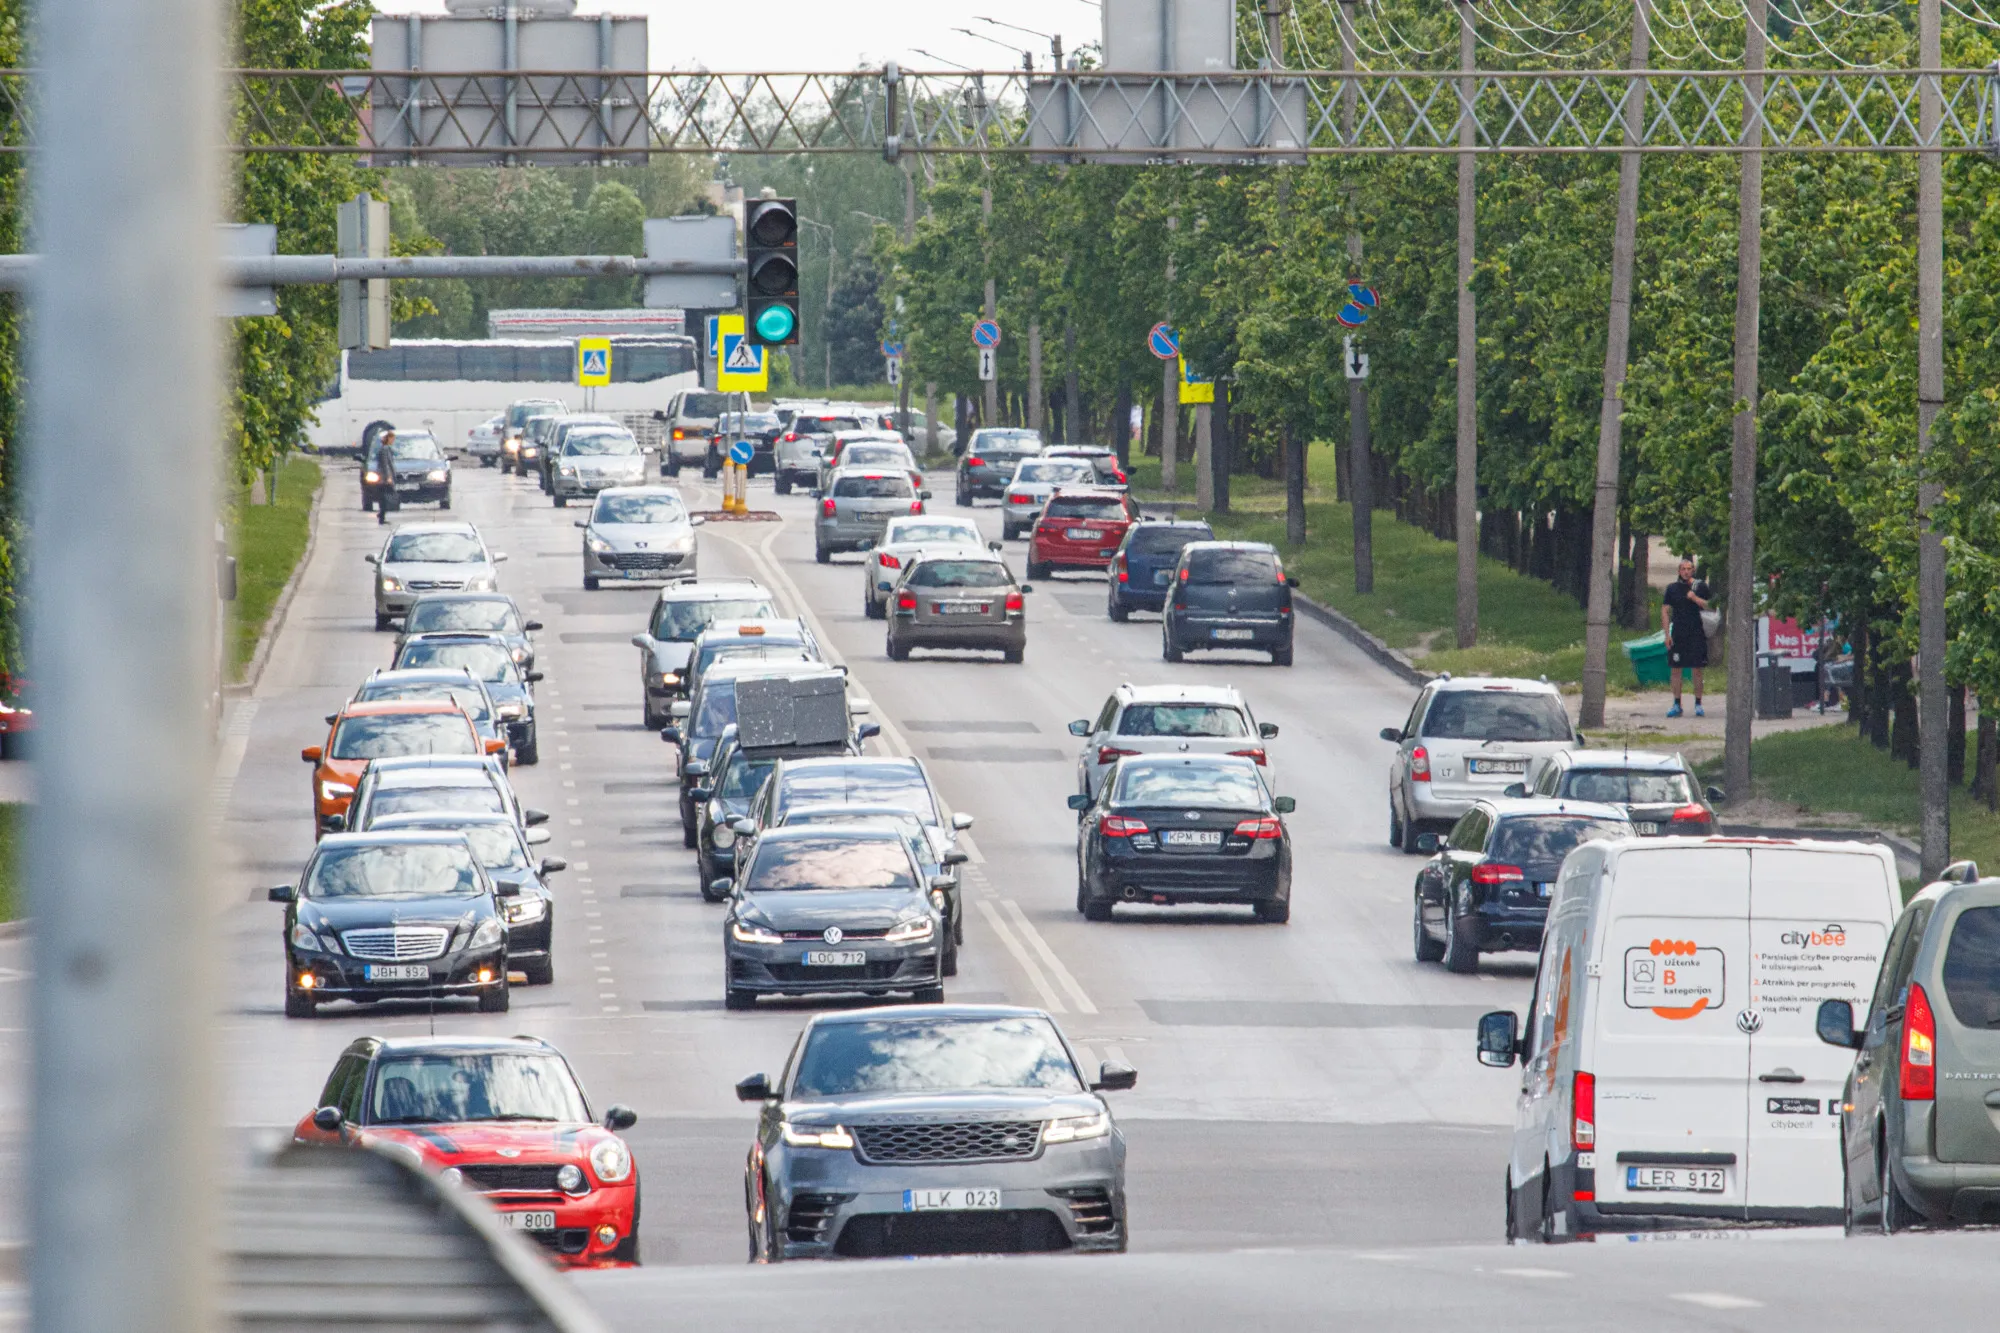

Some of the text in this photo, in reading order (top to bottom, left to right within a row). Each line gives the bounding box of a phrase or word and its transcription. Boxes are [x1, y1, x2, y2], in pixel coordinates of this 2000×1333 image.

[1441, 768, 1452, 777] LT
[1169, 831, 1193, 841] KPM
[1780, 930, 1846, 950] citybee
[841, 952, 864, 964] 712
[373, 967, 398, 978] JBH
[1663, 969, 1677, 986] B
[1761, 979, 1796, 987] Atrakink
[1796, 981, 1809, 989] per
[1663, 986, 1713, 996] kategorijos
[1945, 1071, 2000, 1080] PARTNE
[1782, 1104, 1804, 1113] Google
[1639, 1169, 1721, 1188] LER 912
[914, 1190, 998, 1208] LLK 023
[524, 1213, 552, 1228] 800
